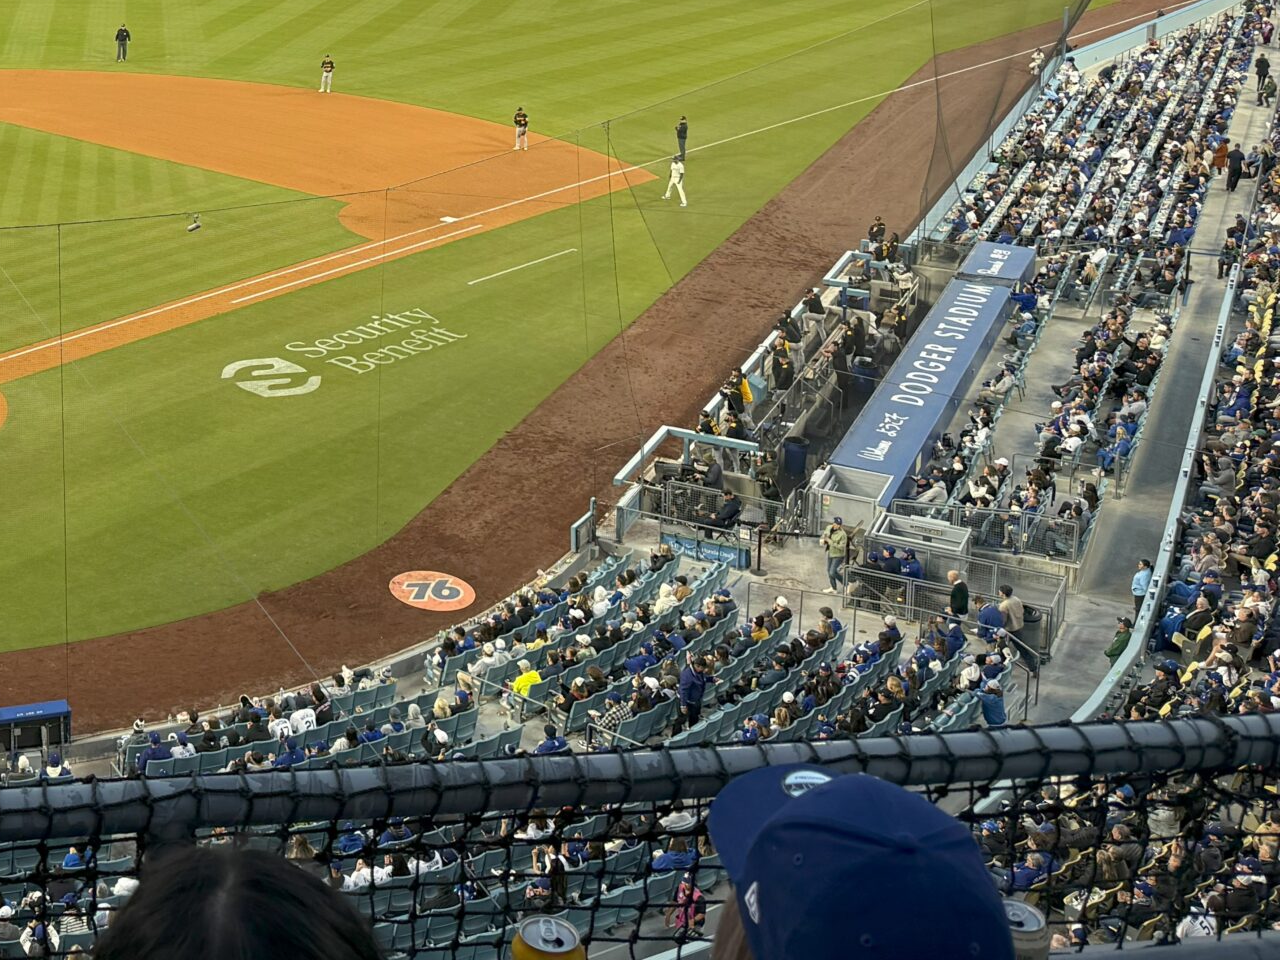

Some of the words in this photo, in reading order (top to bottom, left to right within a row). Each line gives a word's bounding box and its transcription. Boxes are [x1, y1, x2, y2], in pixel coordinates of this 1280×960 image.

[285, 307, 439, 358] Security
[934, 283, 994, 340] STADIUM
[326, 326, 468, 374] Benefit
[890, 344, 958, 407] DODGER
[875, 412, 910, 437] ようこそ
[402, 578, 464, 602] 76
